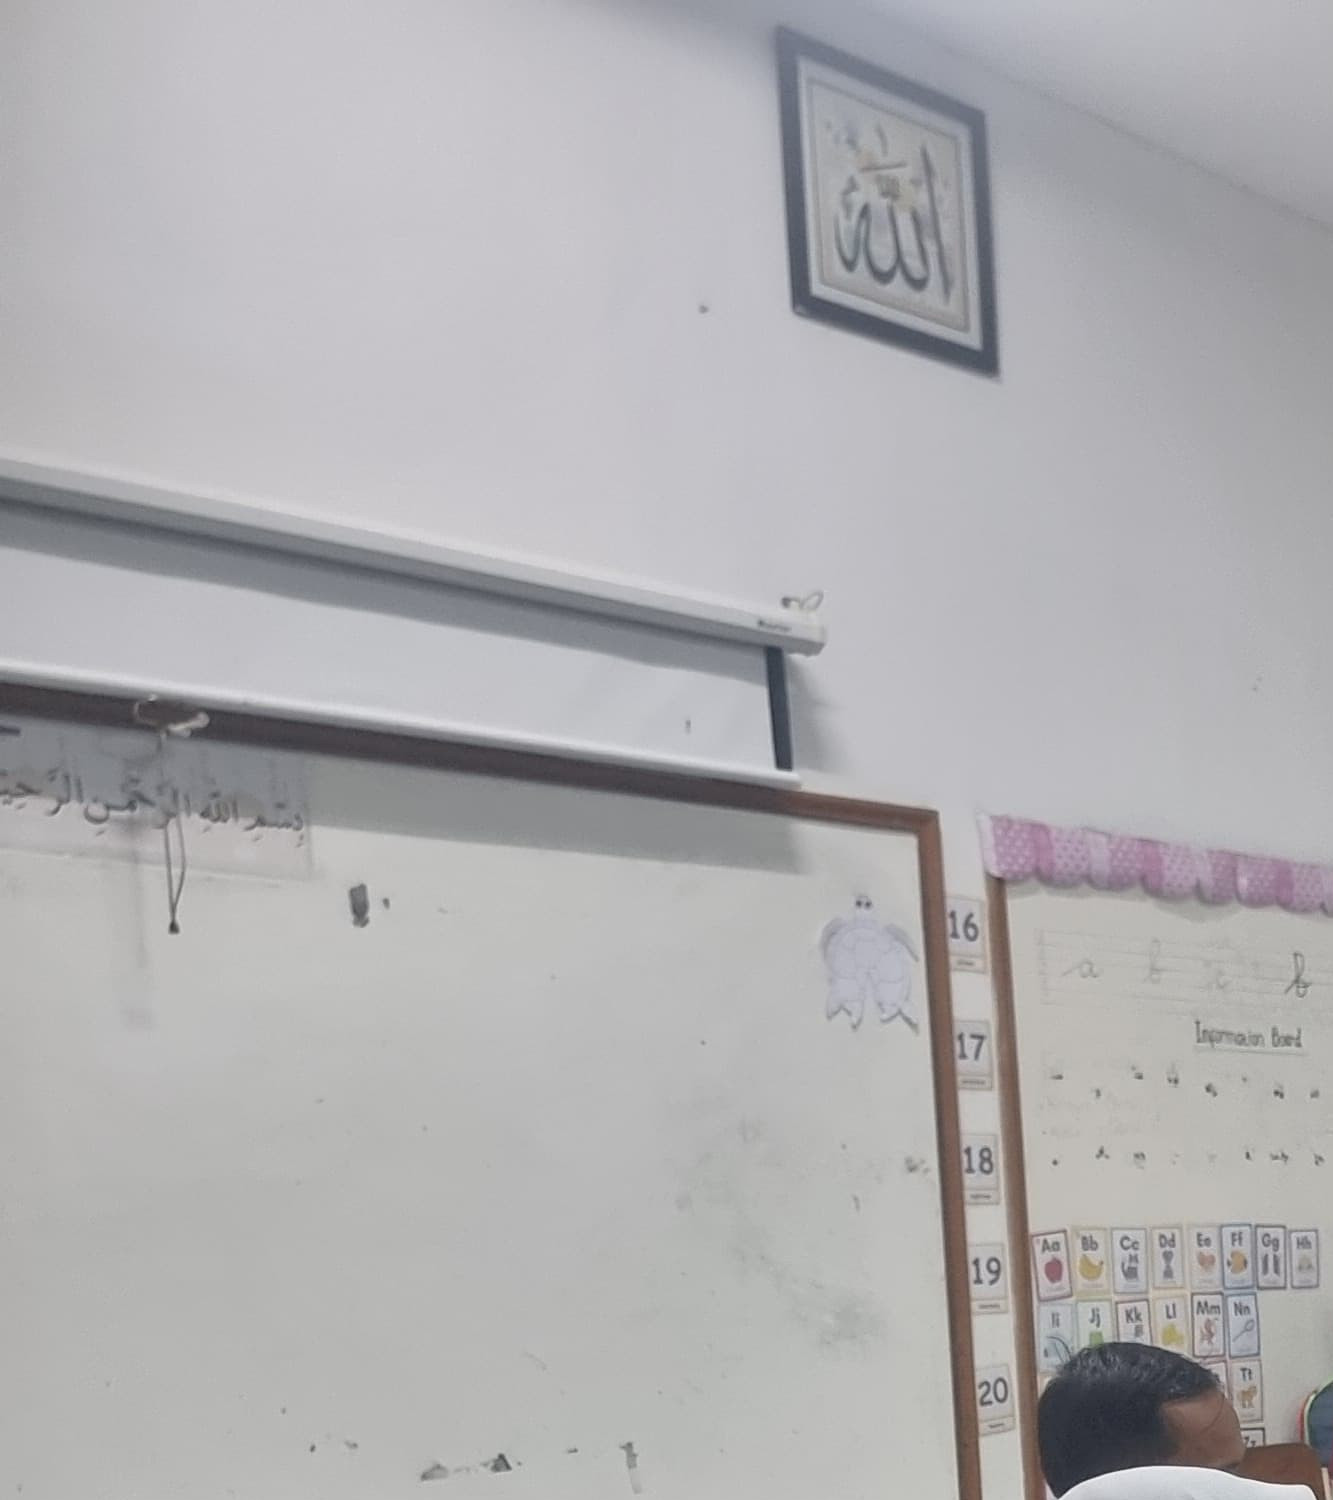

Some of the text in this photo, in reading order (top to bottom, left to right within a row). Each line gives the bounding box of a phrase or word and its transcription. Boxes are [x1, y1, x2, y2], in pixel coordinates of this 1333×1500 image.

[948, 911, 980, 942] 16
[957, 1031, 986, 1061] 17
[963, 1146, 994, 1175] 18
[1041, 1236, 1060, 1252] Aa
[1081, 1233, 1098, 1250] Bb
[1119, 1235, 1140, 1251] Cc
[1159, 1232, 1176, 1248] Dd
[1196, 1232, 1212, 1248] Ee
[1231, 1229, 1243, 1246] Ff
[1261, 1229, 1280, 1252] Gg
[1296, 1235, 1312, 1250] Hh
[972, 1256, 1002, 1286] 19
[1125, 1308, 1142, 1323] Kk
[1165, 1302, 1177, 1319] Ll
[1196, 1302, 1222, 1316] Mm
[1234, 1302, 1250, 1316] Nn
[1089, 1308, 1101, 1328] Jj
[1240, 1367, 1253, 1381] Tt
[977, 1376, 1009, 1407] 20
